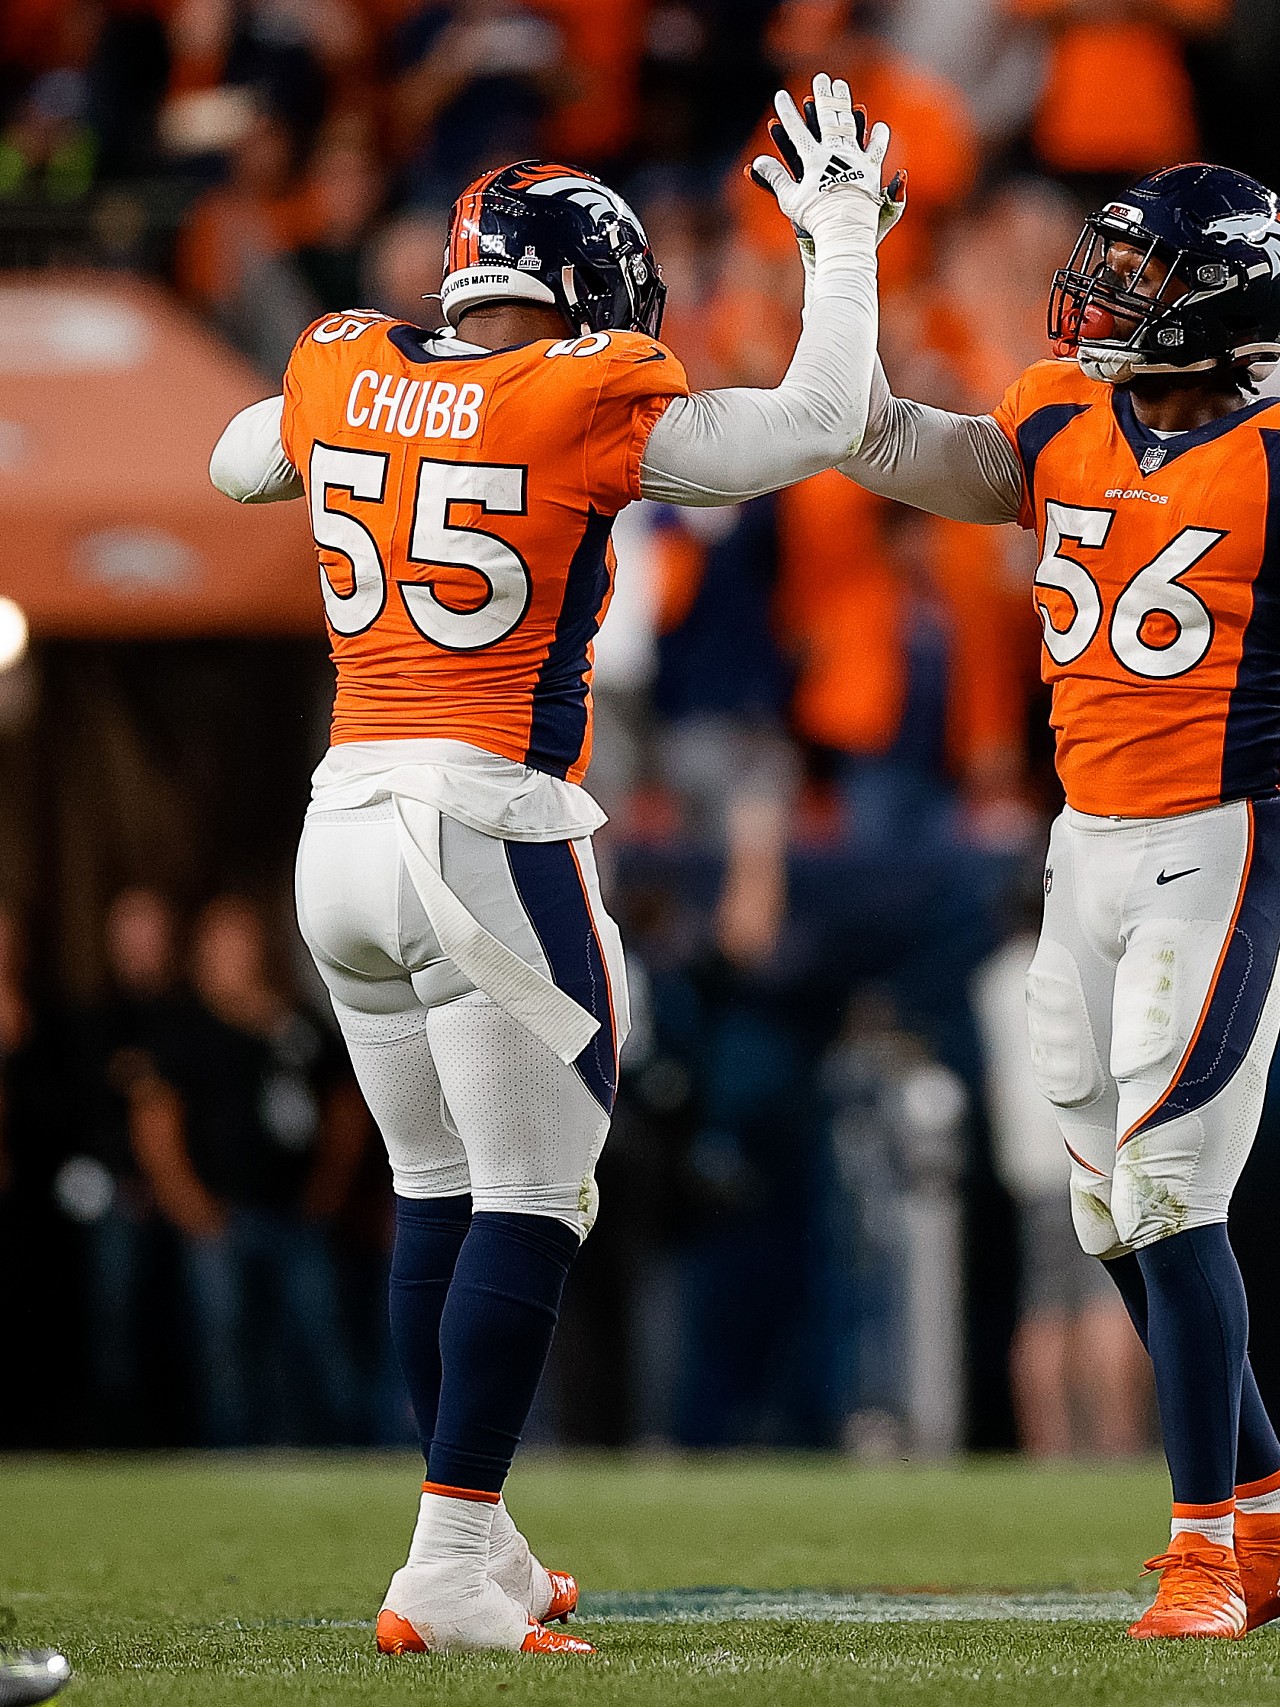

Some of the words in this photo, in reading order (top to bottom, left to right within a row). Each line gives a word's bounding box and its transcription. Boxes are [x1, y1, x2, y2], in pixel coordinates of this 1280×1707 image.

[450, 277, 470, 292] LIVES
[471, 274, 510, 285] MATTER
[345, 368, 486, 440] CHUBB
[1104, 488, 1169, 505] BRONCOS
[309, 438, 533, 652] 55
[1034, 497, 1231, 681] 56
